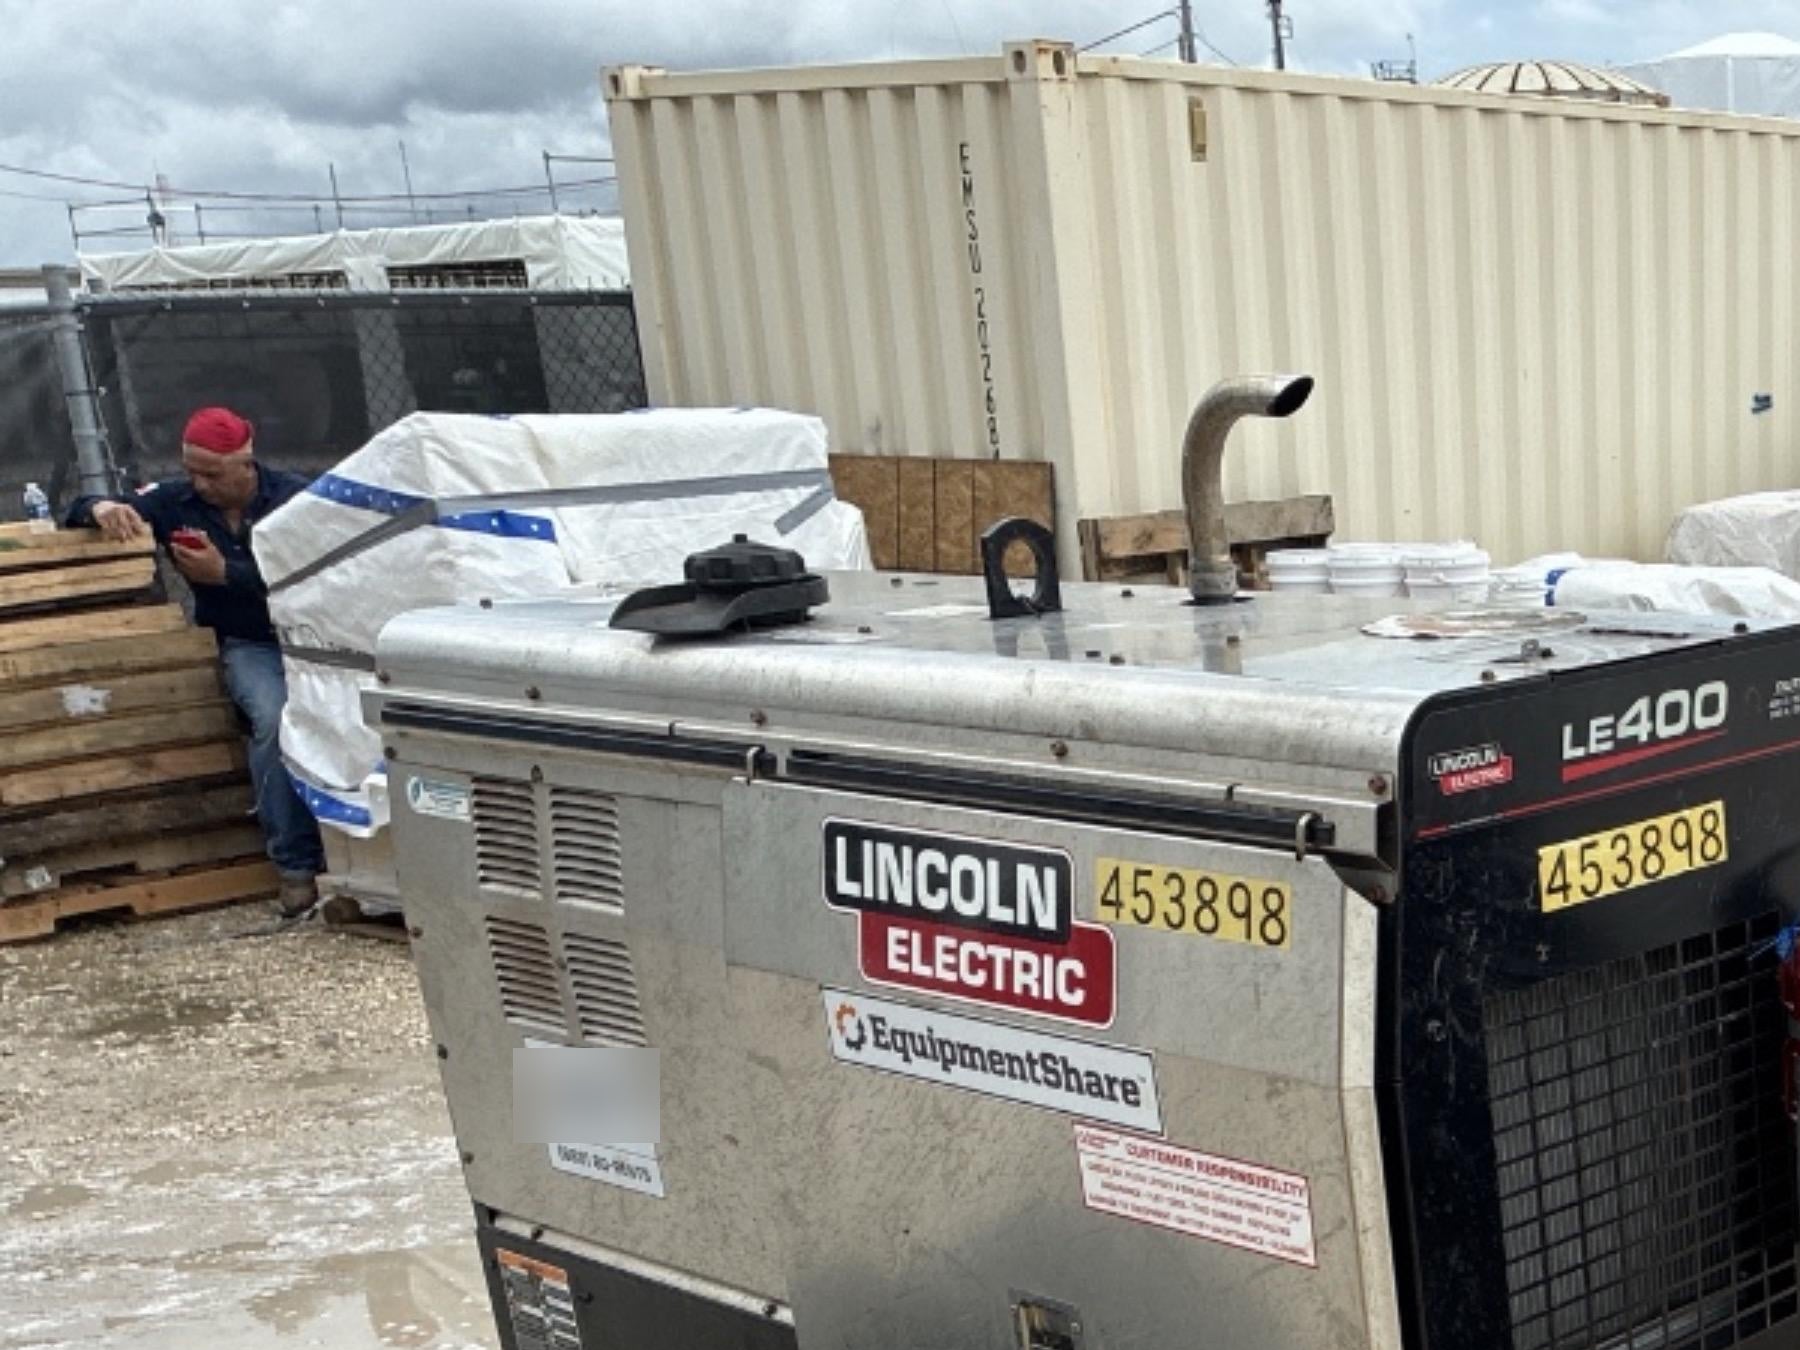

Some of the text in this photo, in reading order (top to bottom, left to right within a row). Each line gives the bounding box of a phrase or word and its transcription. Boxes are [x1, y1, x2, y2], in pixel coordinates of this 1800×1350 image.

[1432, 745, 1499, 775] LINCOLN
[1562, 680, 1728, 761] LE400
[836, 836, 1058, 931] LINCOLN
[1546, 809, 1722, 903] 453898
[1101, 866, 1287, 946] 453898
[887, 926, 1086, 1006] ELECTRIC
[869, 1014, 1141, 1107] EquipmentShare
